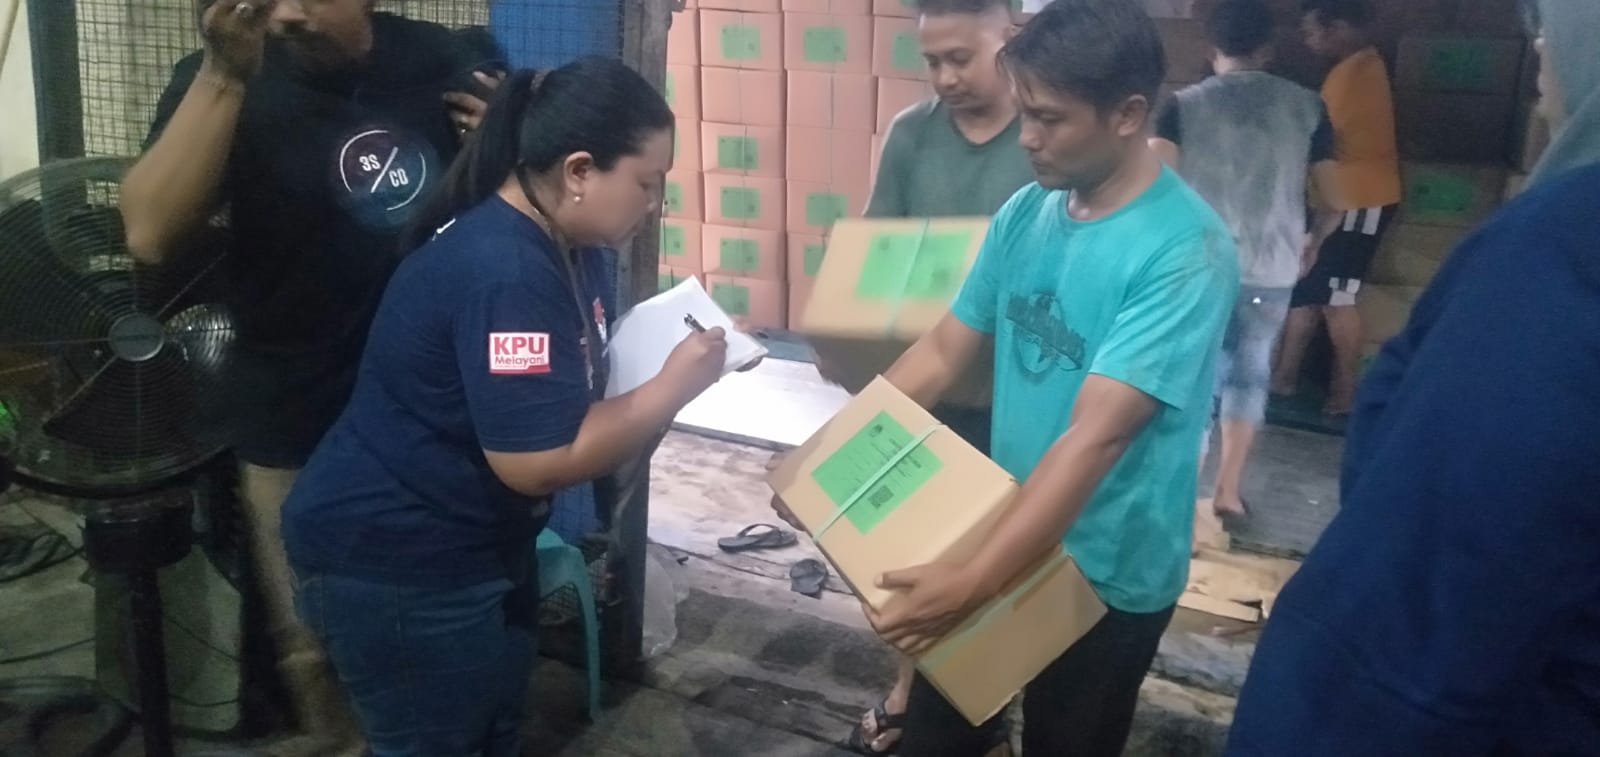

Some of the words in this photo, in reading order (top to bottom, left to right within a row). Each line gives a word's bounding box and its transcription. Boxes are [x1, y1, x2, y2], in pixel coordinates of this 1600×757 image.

[359, 154, 381, 172] 3S
[494, 336, 545, 355] KPU
[495, 355, 545, 368] Melayani
